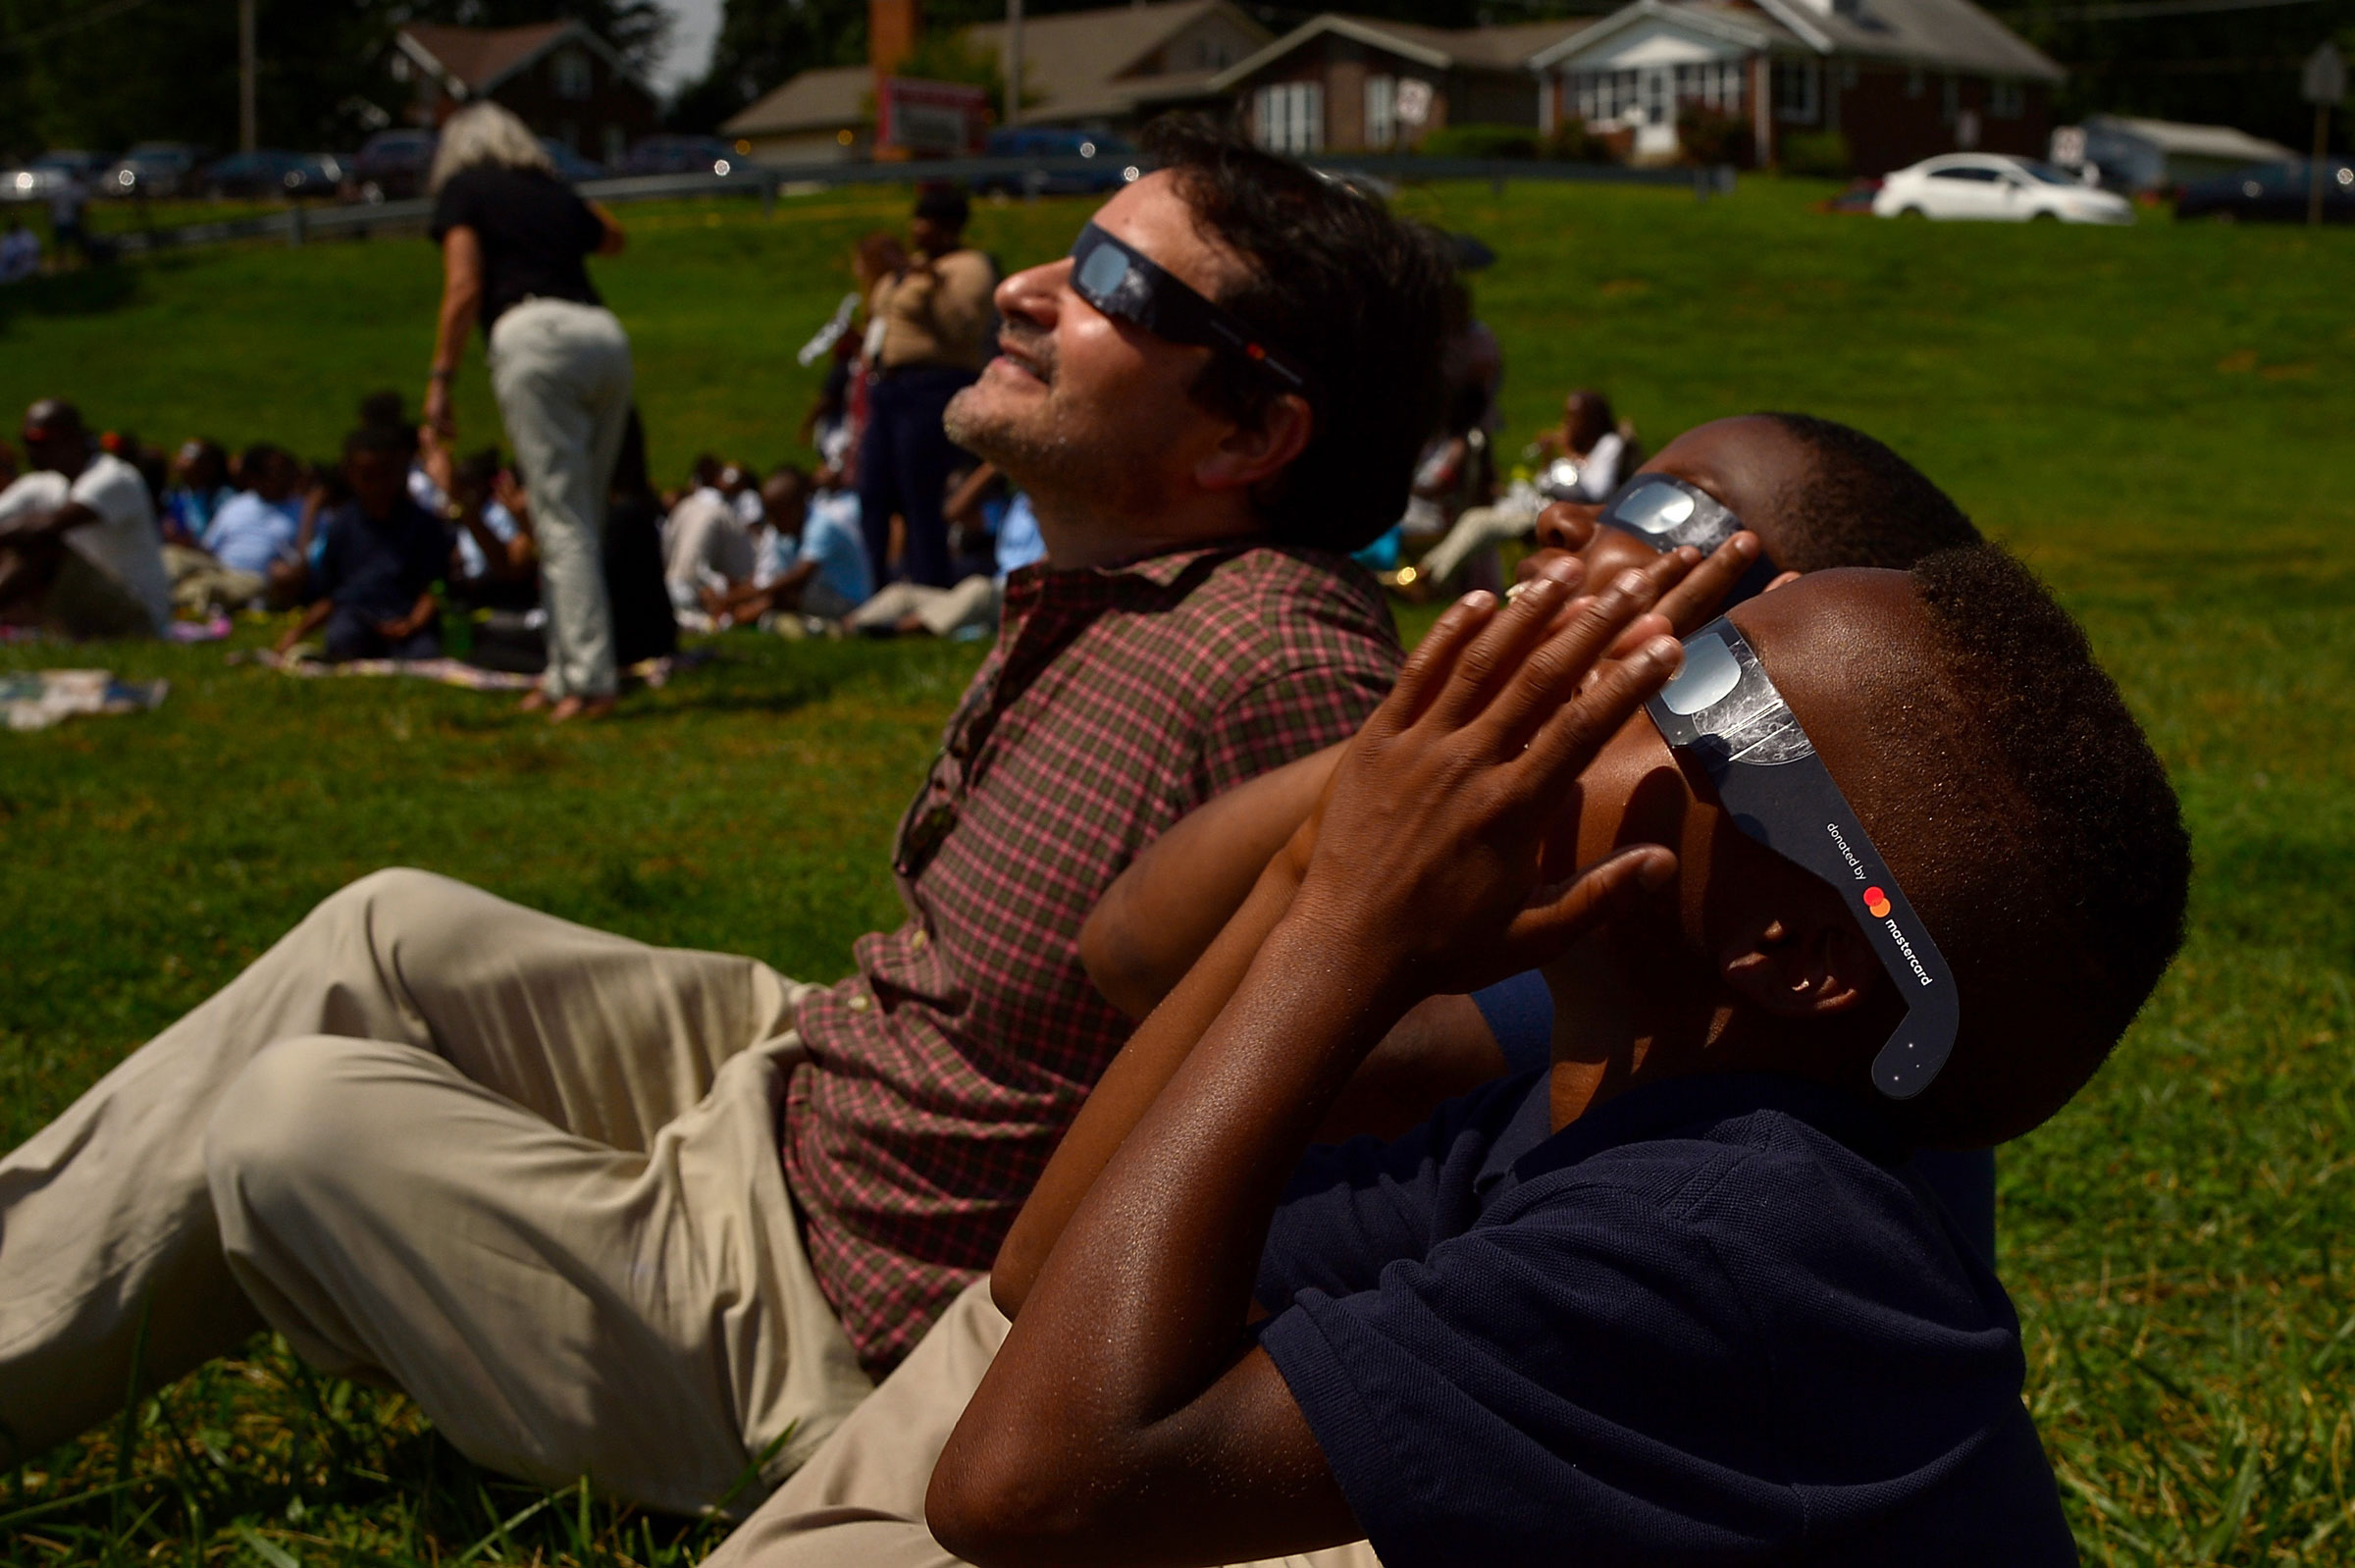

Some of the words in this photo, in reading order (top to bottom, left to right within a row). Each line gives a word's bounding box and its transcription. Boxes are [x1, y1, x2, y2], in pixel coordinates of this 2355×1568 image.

[1827, 823, 1860, 867] donated
[1854, 864, 1867, 880] by
[1885, 918, 1933, 986] mastercard
